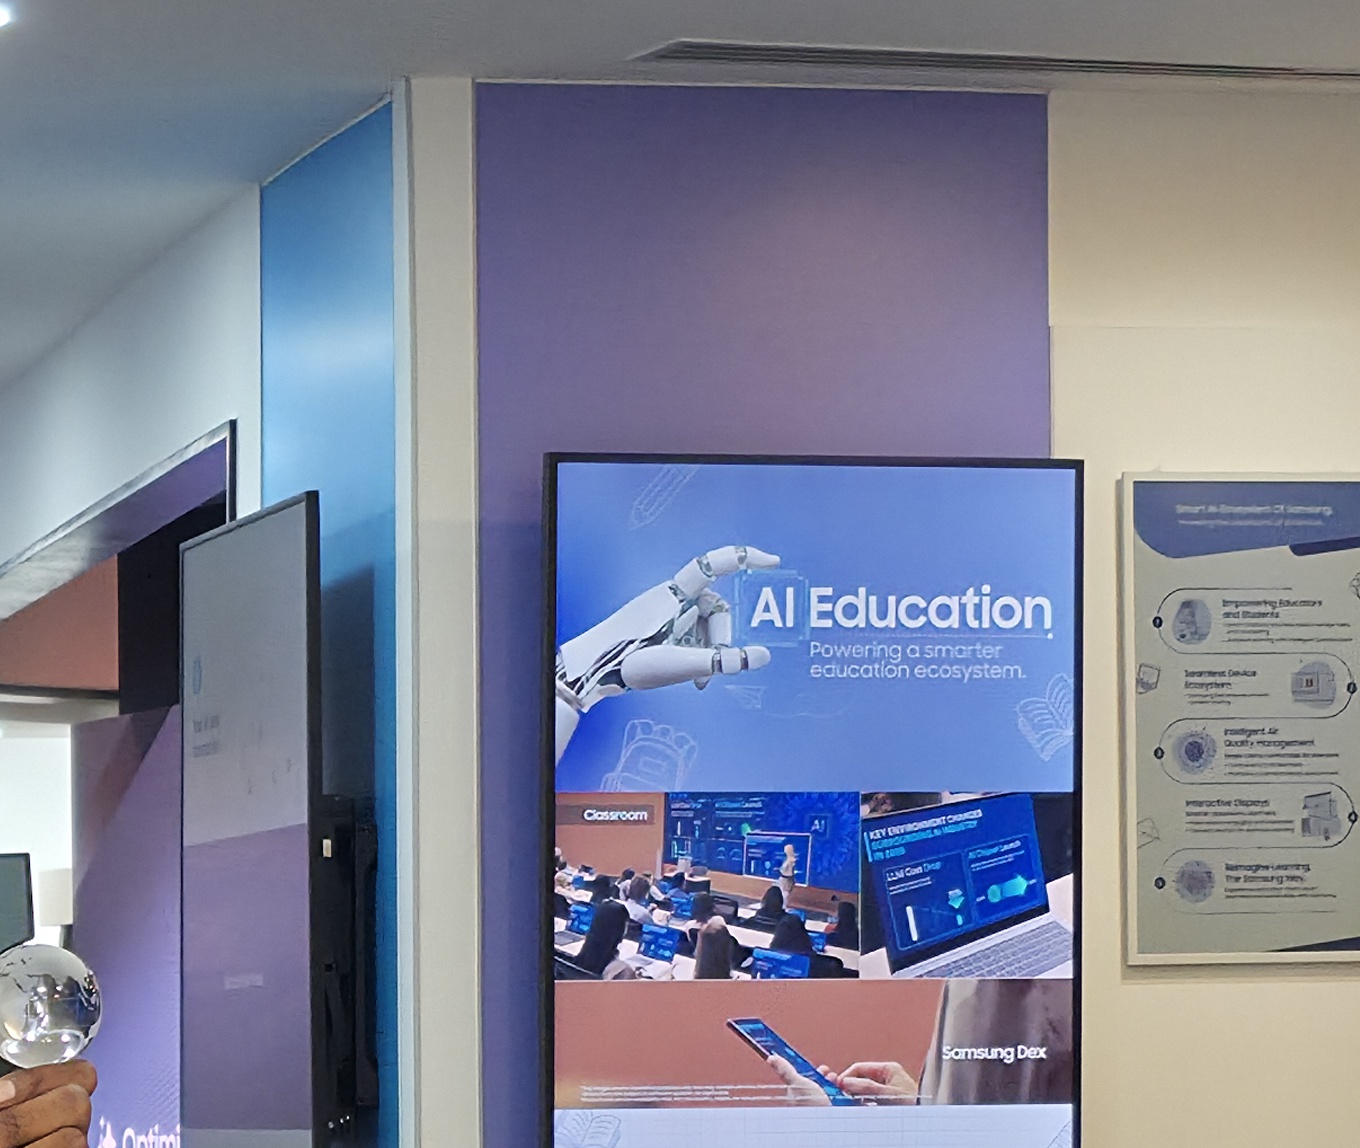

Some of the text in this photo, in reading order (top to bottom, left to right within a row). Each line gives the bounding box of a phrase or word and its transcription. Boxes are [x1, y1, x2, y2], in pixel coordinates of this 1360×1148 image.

[750, 584, 1053, 630] AI Education
[809, 641, 1003, 663] Powering a smarter
[809, 661, 1027, 684] education ecosystem.
[583, 808, 649, 822] Classroom
[941, 1044, 1047, 1064] Samsung Dex
